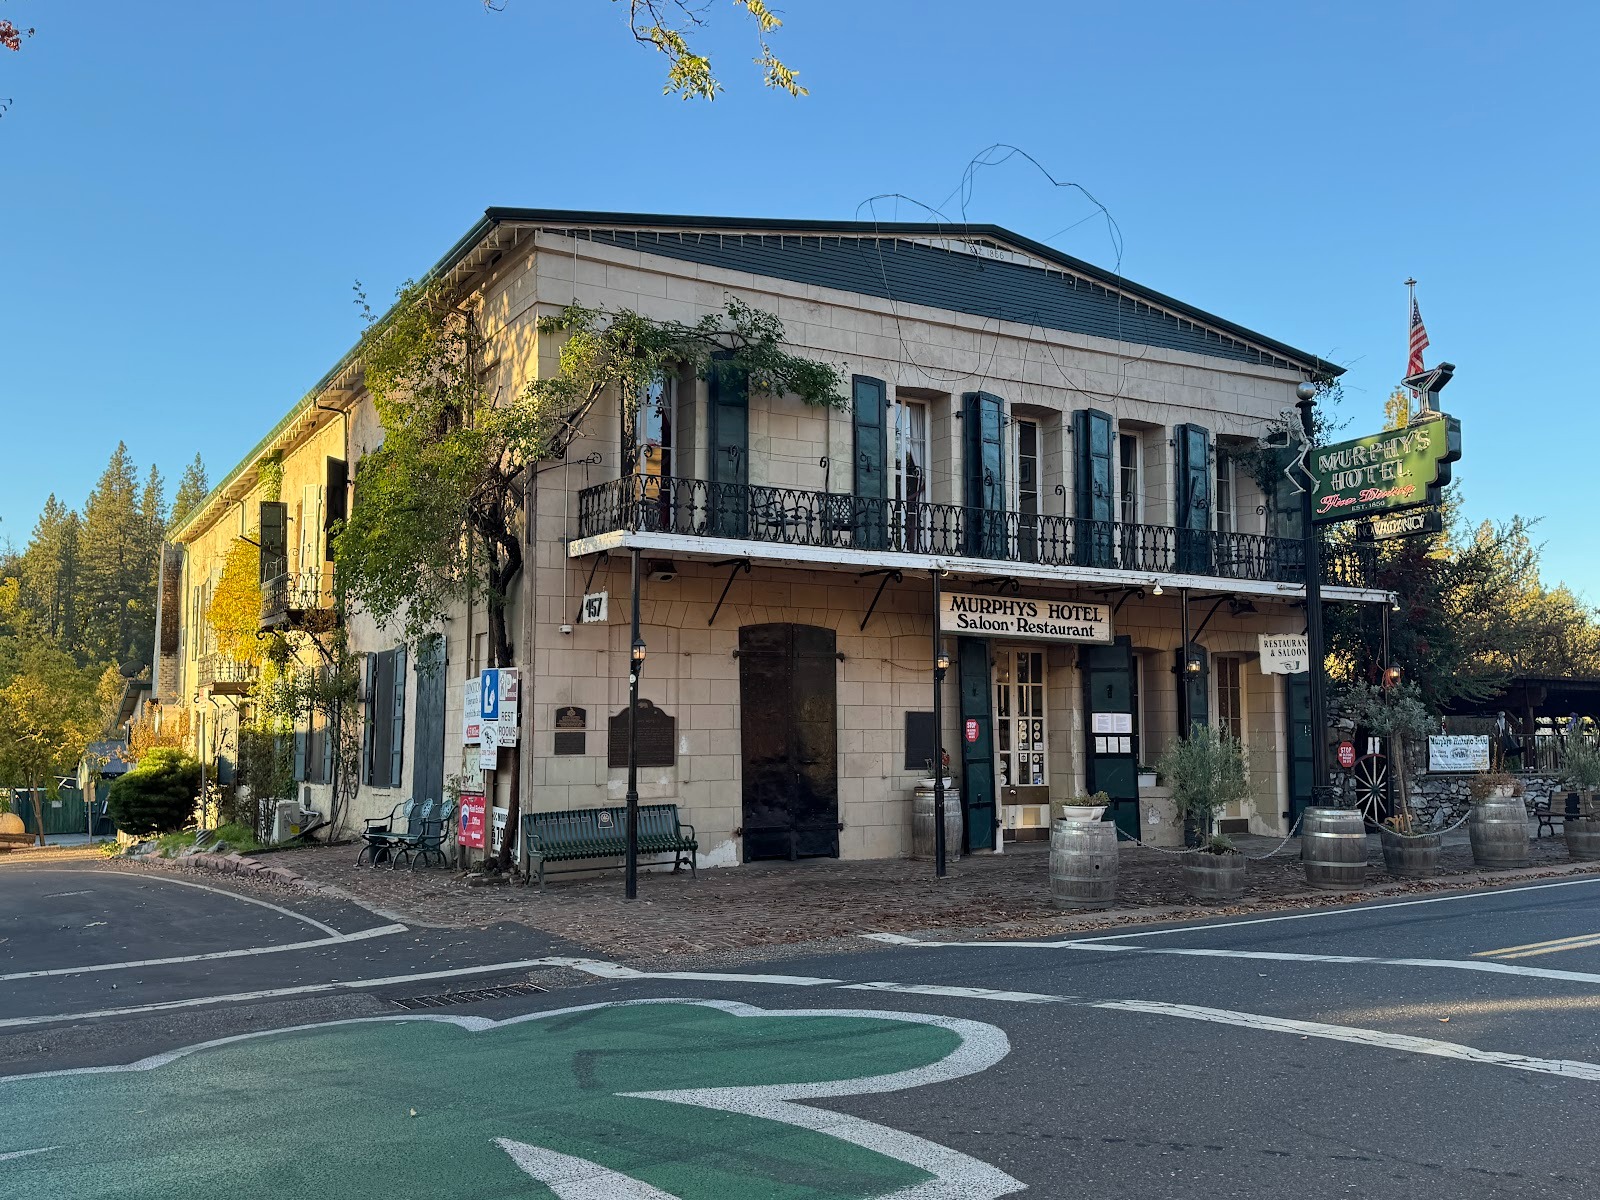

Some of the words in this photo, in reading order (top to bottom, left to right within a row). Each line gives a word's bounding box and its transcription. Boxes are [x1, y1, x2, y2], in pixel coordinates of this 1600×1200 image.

[1331, 459, 1413, 491] HOTEL
[1359, 484, 1417, 503] Dining
[1351, 504, 1368, 512] EST.
[1357, 524, 1374, 538] NO
[1373, 513, 1426, 536] VACANCY
[585, 597, 603, 618] 457
[950, 596, 1038, 617] MURPHYS
[1048, 603, 1103, 623] HOTEL
[957, 613, 1010, 631] Saloon
[1016, 617, 1095, 637] Restaurant
[1263, 639, 1308, 648] RESTAURAN
[1270, 649, 1276, 657] &
[1278, 648, 1307, 657] SALOON
[501, 711, 514, 722] REST
[499, 726, 516, 737] ROOMS
[1340, 746, 1352, 754] STOP
